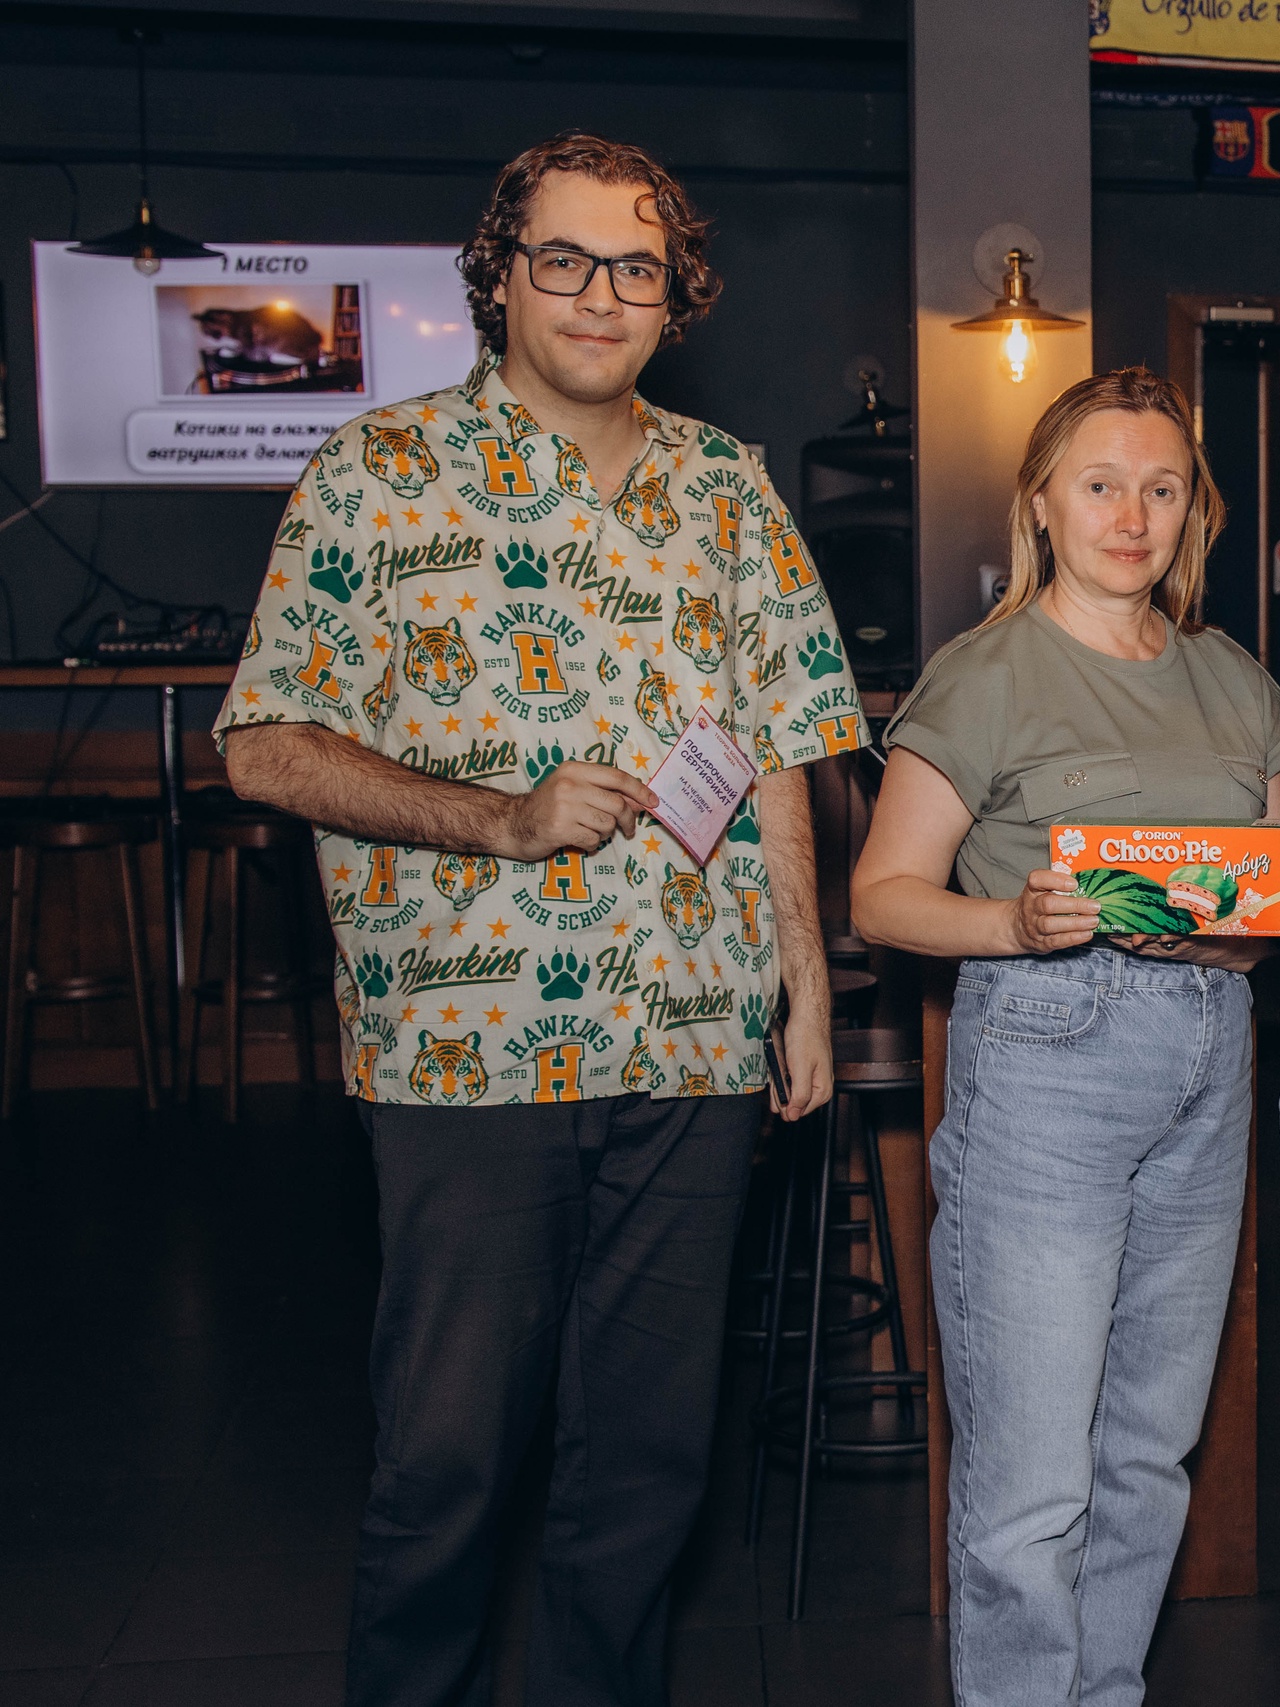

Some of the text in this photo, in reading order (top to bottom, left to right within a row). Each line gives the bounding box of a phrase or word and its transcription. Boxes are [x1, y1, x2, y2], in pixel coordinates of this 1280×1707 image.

[1238, 0, 1268, 23] de
[220, 256, 309, 273] 1 МЕСТО
[330, 462, 354, 478] 1952
[450, 437, 538, 497] ESTD H
[457, 482, 501, 518] HIGH
[684, 468, 763, 518] HAWKINS
[690, 512, 712, 523] ESTD
[744, 529, 761, 540] 195
[697, 535, 727, 574] HIGH
[768, 530, 817, 599] H
[761, 594, 795, 619] HIGH
[480, 602, 586, 648] HAWKINS
[274, 638, 303, 655] ESTD
[483, 630, 586, 695] ESTD H 1952
[269, 666, 298, 698] HIGH
[491, 682, 591, 723] HIGH SCHOOL
[608, 695, 625, 705] 952
[735, 723, 750, 734] 952
[792, 745, 817, 759] ESTD
[680, 750, 732, 807] СЕРТИФИКАТ
[684, 738, 738, 800] ПОДАРОЧНЫЙ
[679, 776, 689, 787] НА
[690, 787, 713, 814] ЧЕЛОВЕКА
[681, 787, 692, 799] НА
[1144, 831, 1182, 841] ORION
[400, 869, 421, 879] 1952
[512, 863, 536, 873] ESTD
[594, 865, 616, 875] 1952
[1222, 852, 1271, 884] Арбуз
[369, 897, 424, 933] SCHOOL
[512, 888, 618, 931] HIGH SCHOOL
[638, 899, 653, 909] 952
[721, 907, 739, 918] ESTD
[723, 931, 749, 968] HIGH
[397, 943, 529, 996] Hawkins
[641, 981, 735, 1032] Hawkins
[503, 1015, 614, 1060] HAWKINS
[379, 1069, 399, 1079] 1952
[500, 1069, 527, 1080] ESTD
[589, 1066, 610, 1077] 1952
